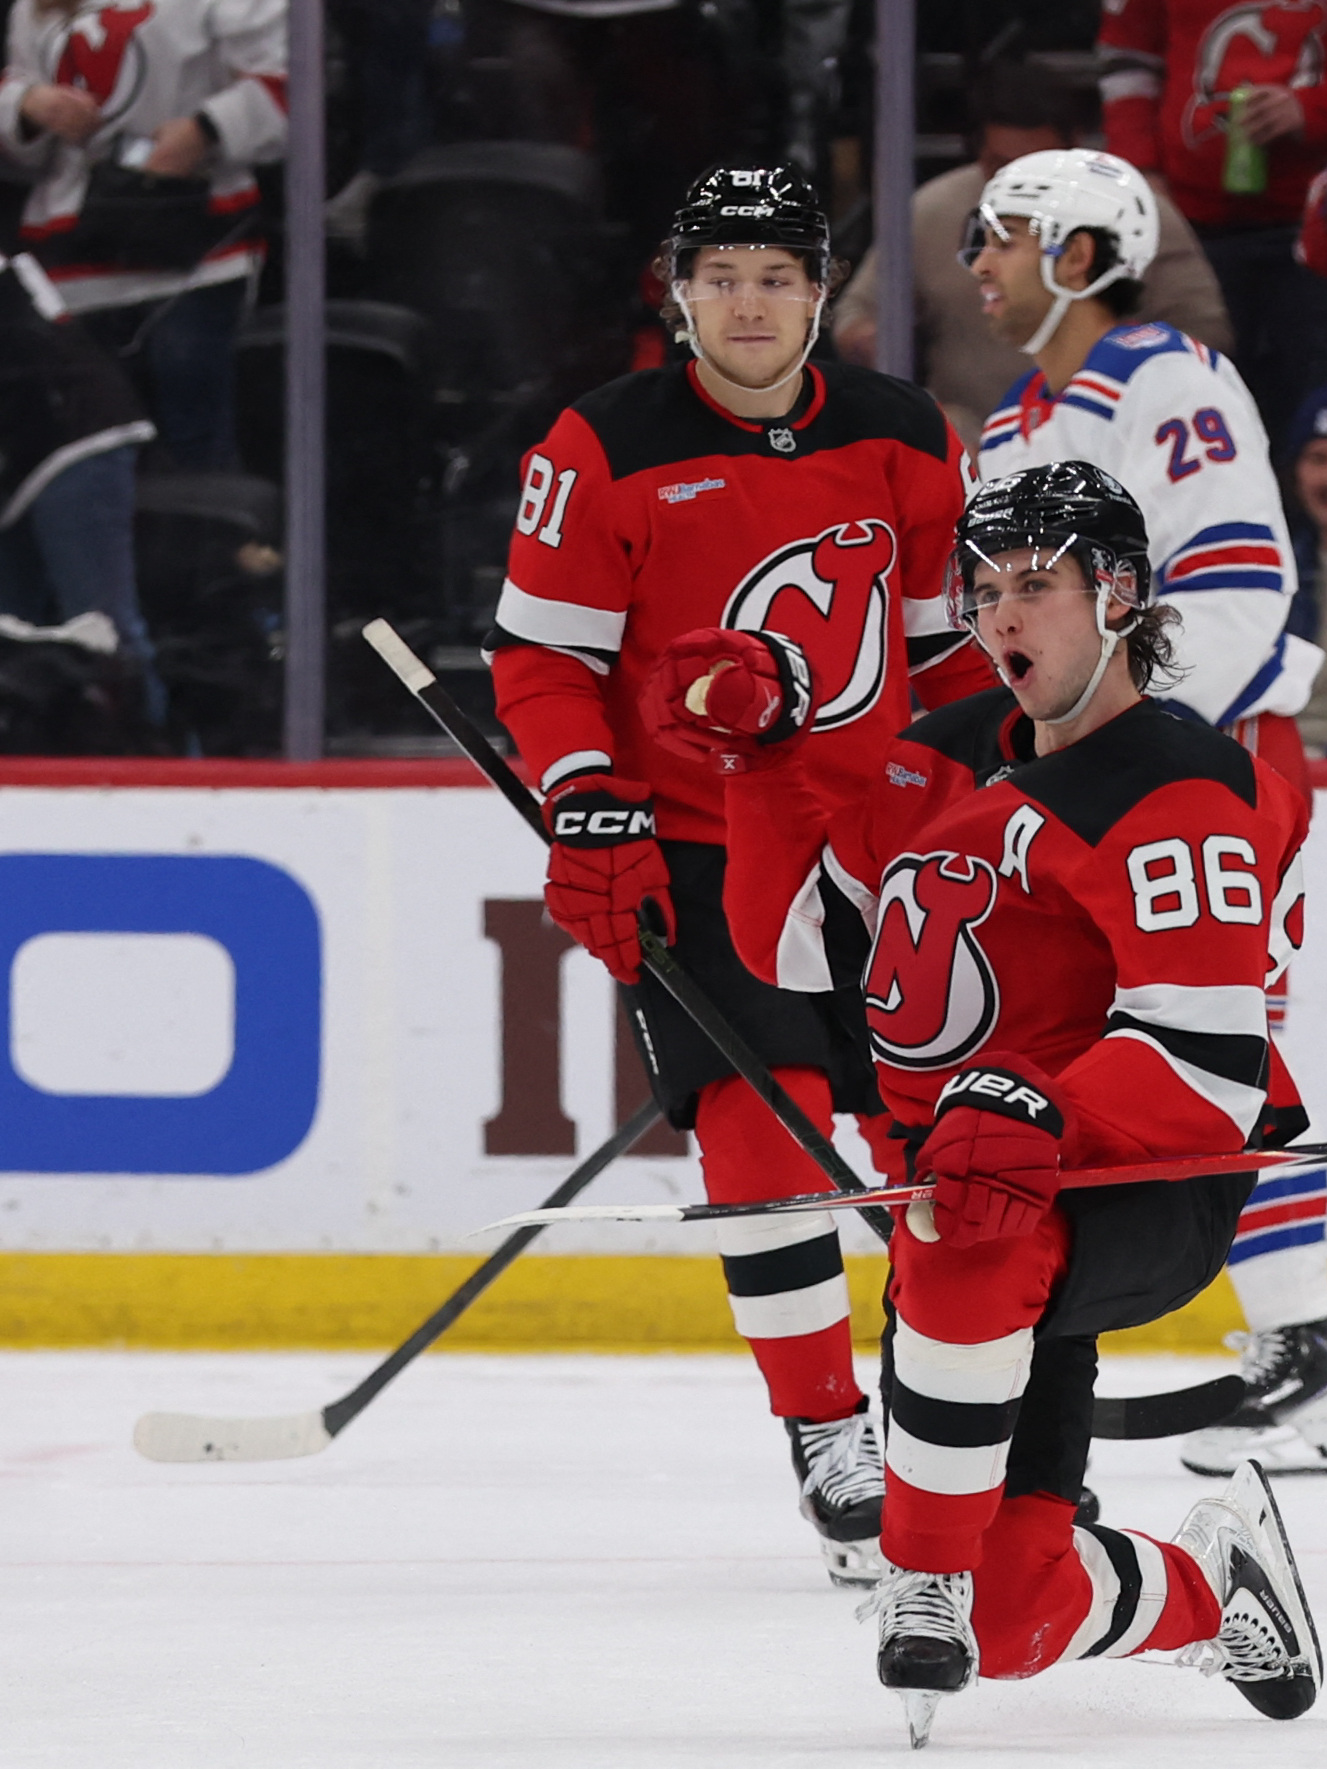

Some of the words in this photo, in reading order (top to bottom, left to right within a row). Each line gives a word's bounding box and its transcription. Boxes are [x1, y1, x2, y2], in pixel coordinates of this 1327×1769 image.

[720, 206, 775, 217] CCM
[1154, 407, 1238, 484] 29
[515, 452, 577, 549] 81
[555, 810, 656, 836] CCM
[998, 803, 1047, 895] A
[1126, 834, 1264, 934] 86
[935, 1071, 1049, 1119] UER
[1258, 1588, 1294, 1635] BAUER
